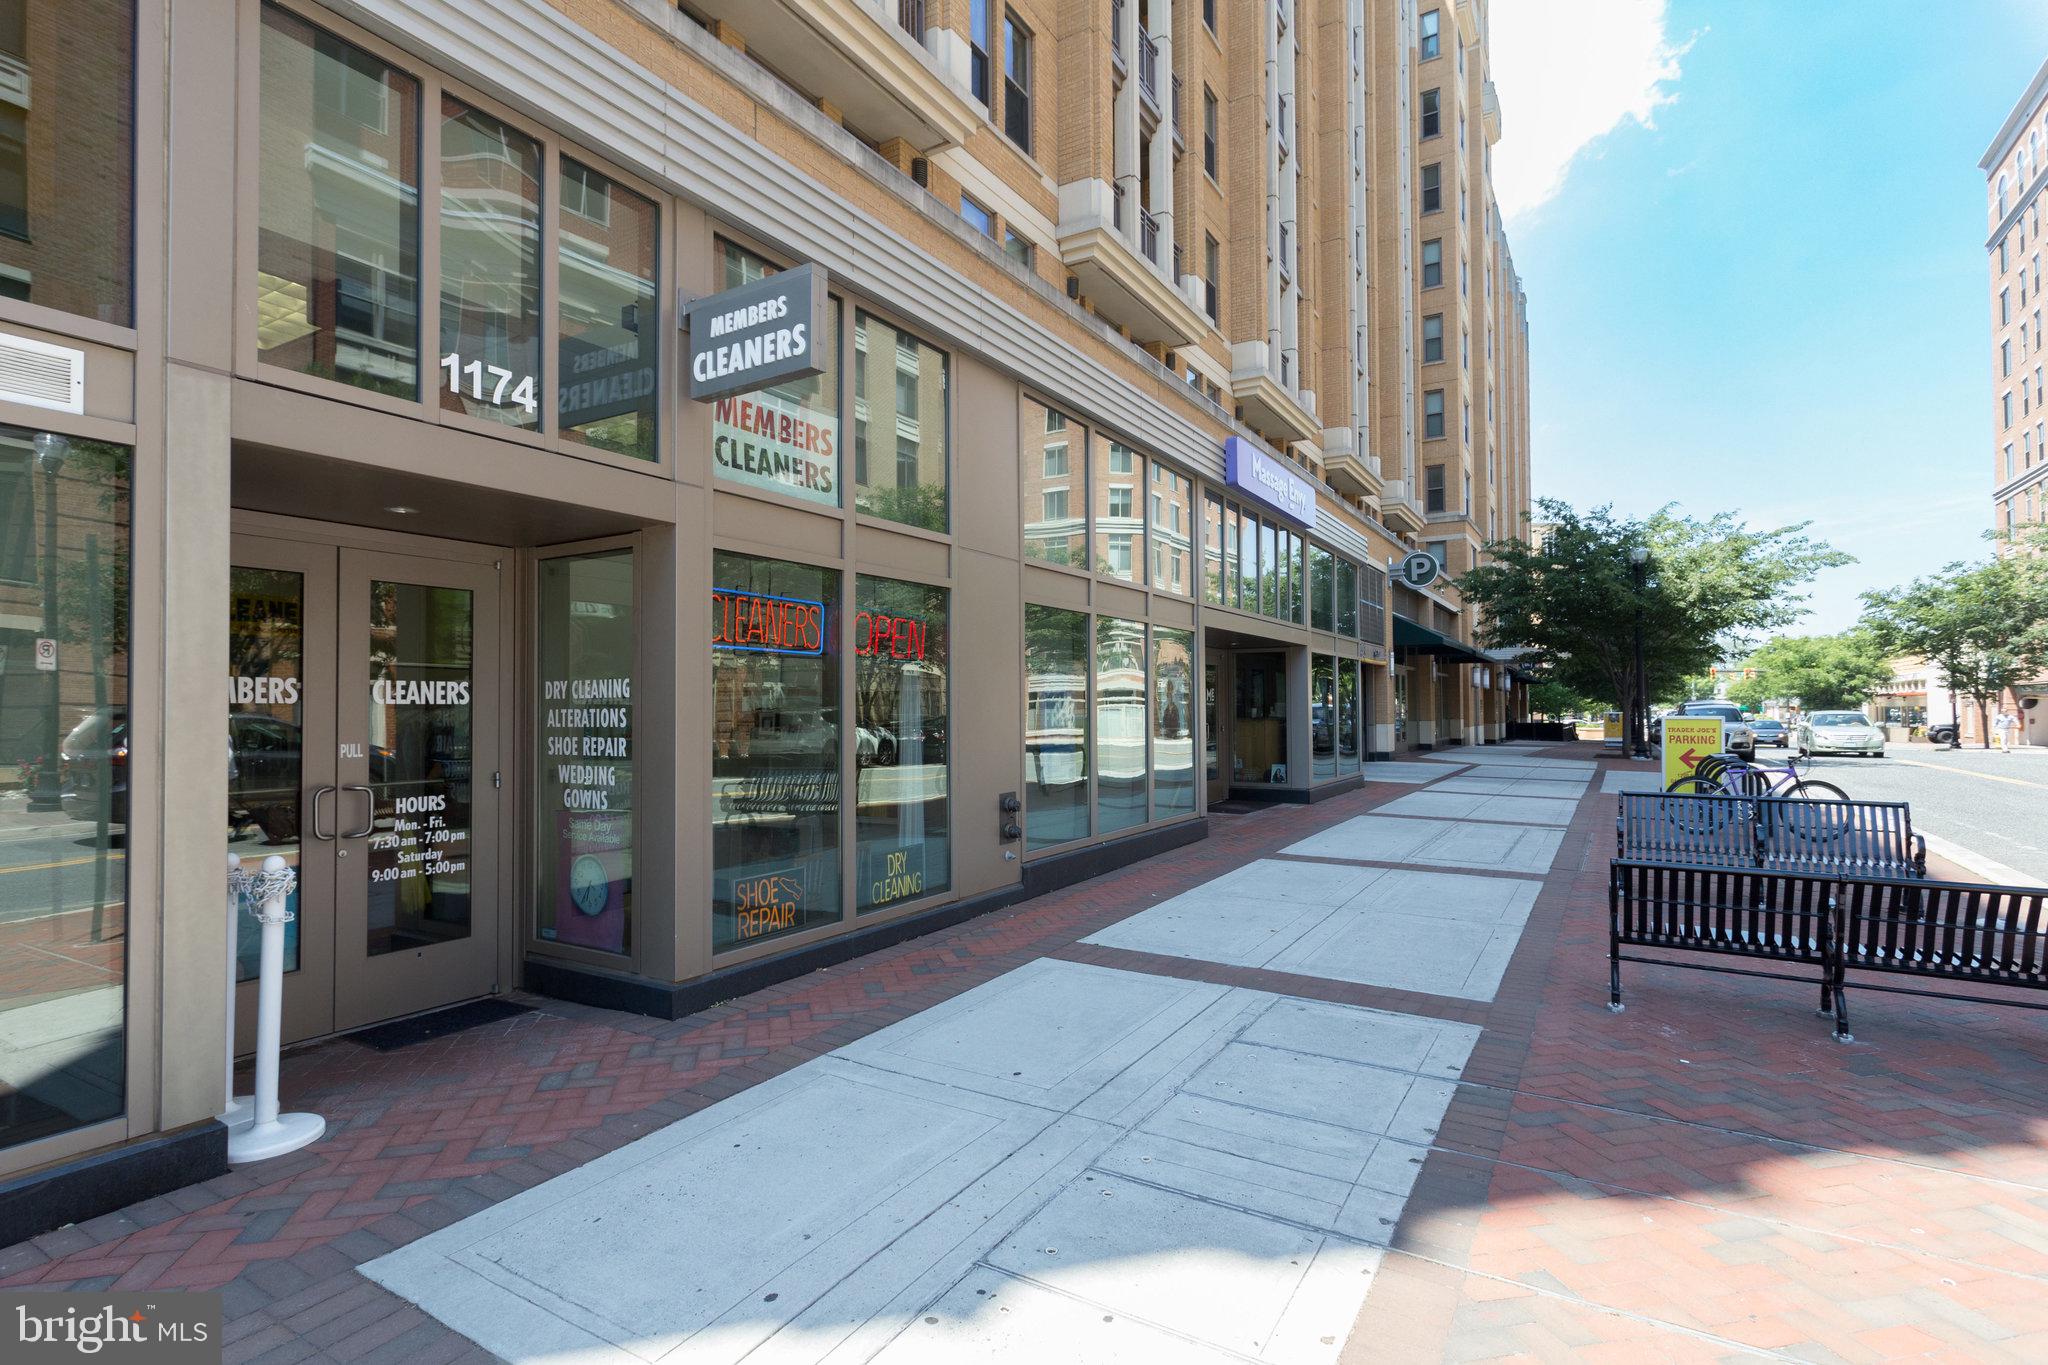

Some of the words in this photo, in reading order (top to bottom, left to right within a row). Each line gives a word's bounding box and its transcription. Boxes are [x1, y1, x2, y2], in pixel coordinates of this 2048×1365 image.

[710, 295, 788, 338] MEMBERS
[693, 323, 806, 382] CLEANERS
[440, 352, 538, 414] 1174
[714, 396, 833, 457] MEMBERS
[714, 434, 833, 494] CLEANERS
[1251, 453, 1288, 504] Massage
[1409, 557, 1431, 582] P
[852, 611, 927, 660] OPEN
[372, 680, 470, 706] CLEANERS
[545, 680, 568, 700] DRY
[571, 678, 630, 699] CLEANING
[547, 707, 628, 728] ALTERATIONS
[340, 743, 363, 758] PULL
[547, 736, 579, 756] SHOE
[582, 736, 627, 758] REPAIR
[1669, 735, 1716, 744] PARKING
[558, 764, 617, 786] WEDDING
[395, 794, 447, 815] HOURS
[563, 788, 609, 810] GOWNS
[394, 818, 422, 833] Mon.
[429, 815, 447, 829] Fri.
[373, 834, 400, 851] 7:30
[400, 836, 417, 847] am
[424, 829, 450, 845] 7:00
[450, 830, 466, 844] pm
[397, 847, 444, 865] Saturday
[886, 850, 908, 877] DRY
[371, 866, 400, 884] 9:00
[400, 867, 417, 880] am
[425, 860, 450, 876] 5:00
[450, 861, 466, 875] pm
[736, 876, 780, 912] SHOE
[871, 871, 923, 905] CLEANING
[736, 901, 797, 940] REPAIR
